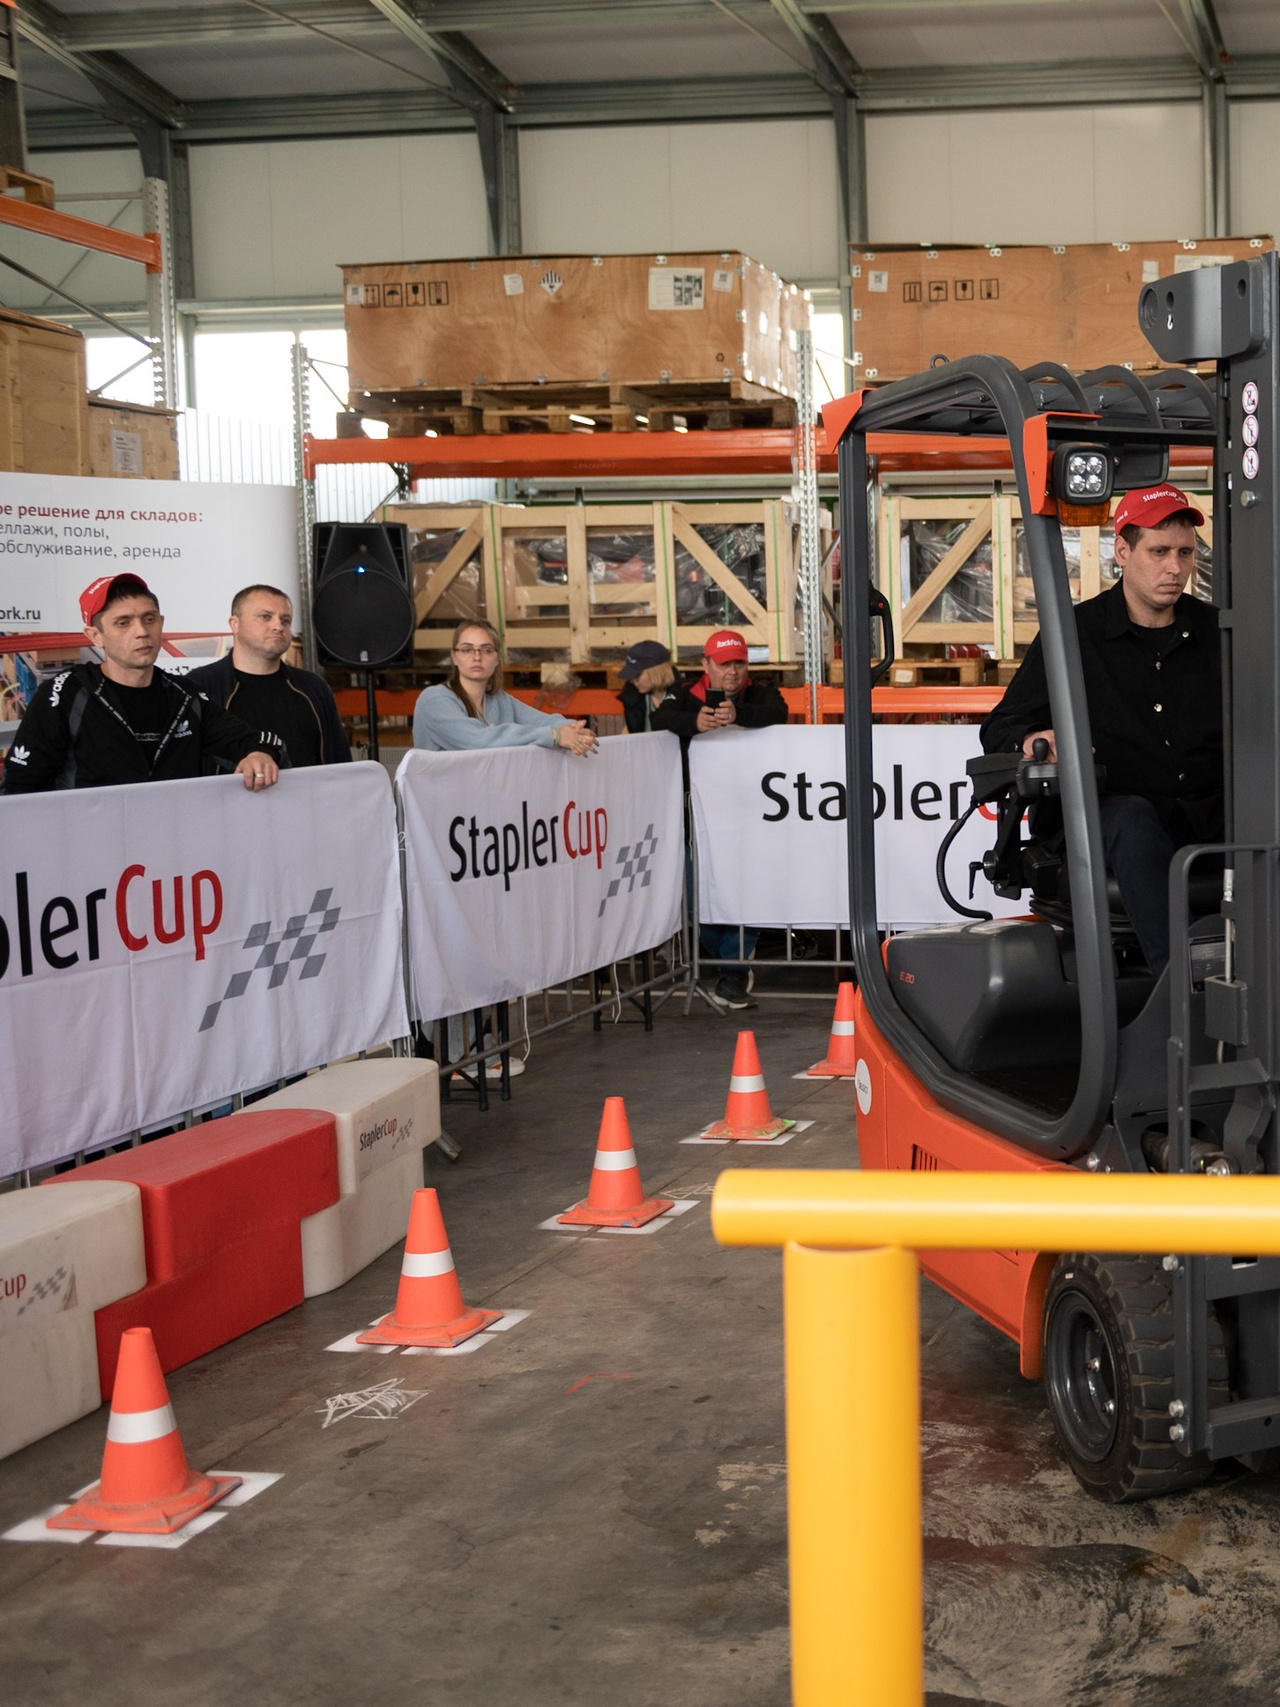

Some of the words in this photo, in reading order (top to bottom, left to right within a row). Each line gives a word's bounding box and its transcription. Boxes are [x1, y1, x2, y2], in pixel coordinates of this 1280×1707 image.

[18, 505, 90, 519] решение
[95, 509, 125, 521] для
[130, 510, 203, 523] складов:
[63, 526, 110, 539] полы,
[0, 540, 118, 558] обслуживание,
[122, 545, 181, 560] аренда
[449, 801, 608, 891] StaplerCup
[0, 863, 223, 982] lerCup
[359, 1117, 397, 1151] StaplerCup
